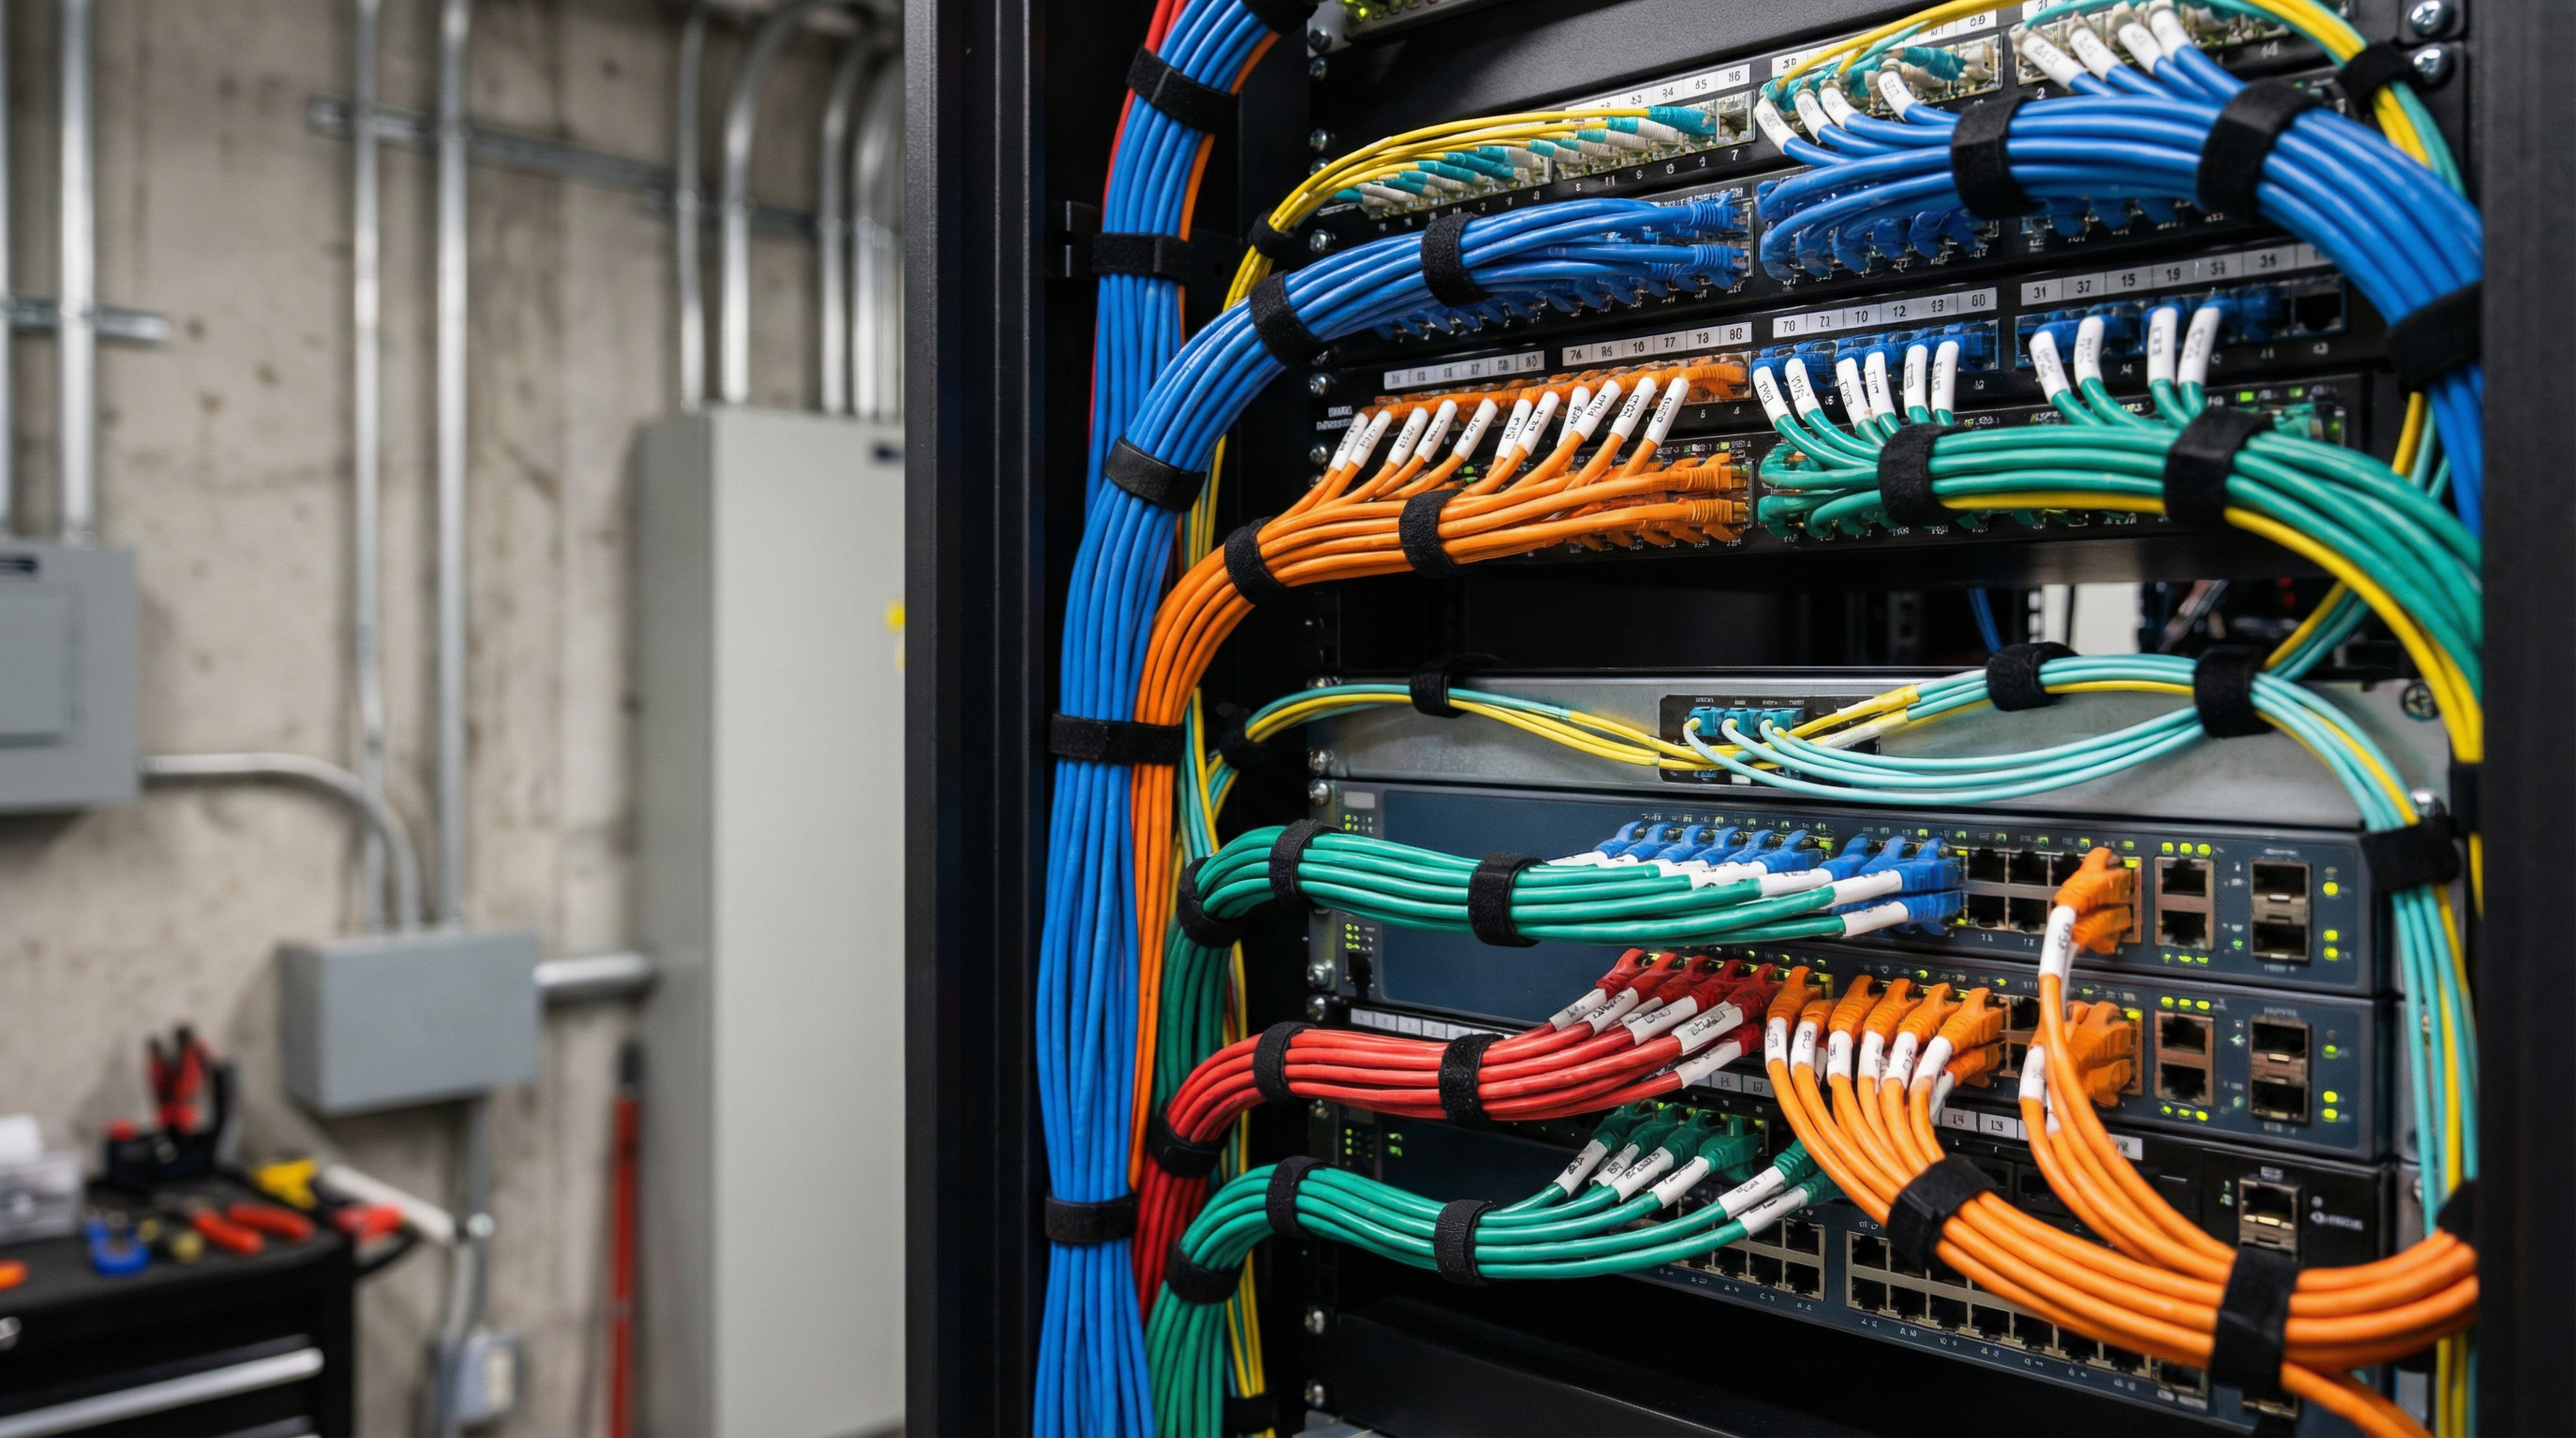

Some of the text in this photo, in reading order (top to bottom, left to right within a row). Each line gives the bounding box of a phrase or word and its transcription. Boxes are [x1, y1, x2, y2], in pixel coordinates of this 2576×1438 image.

[1731, 149, 1739, 161] 7
[2033, 286, 2046, 299] 31
[2076, 280, 2092, 294] 37
[2122, 273, 2136, 286] 15
[2167, 268, 2181, 282] 19
[1783, 319, 1795, 332] 70
[1855, 310, 1868, 324] 10
[1892, 304, 1907, 317] 12
[1664, 336, 1676, 348] 17
[1701, 409, 1706, 418] 6
